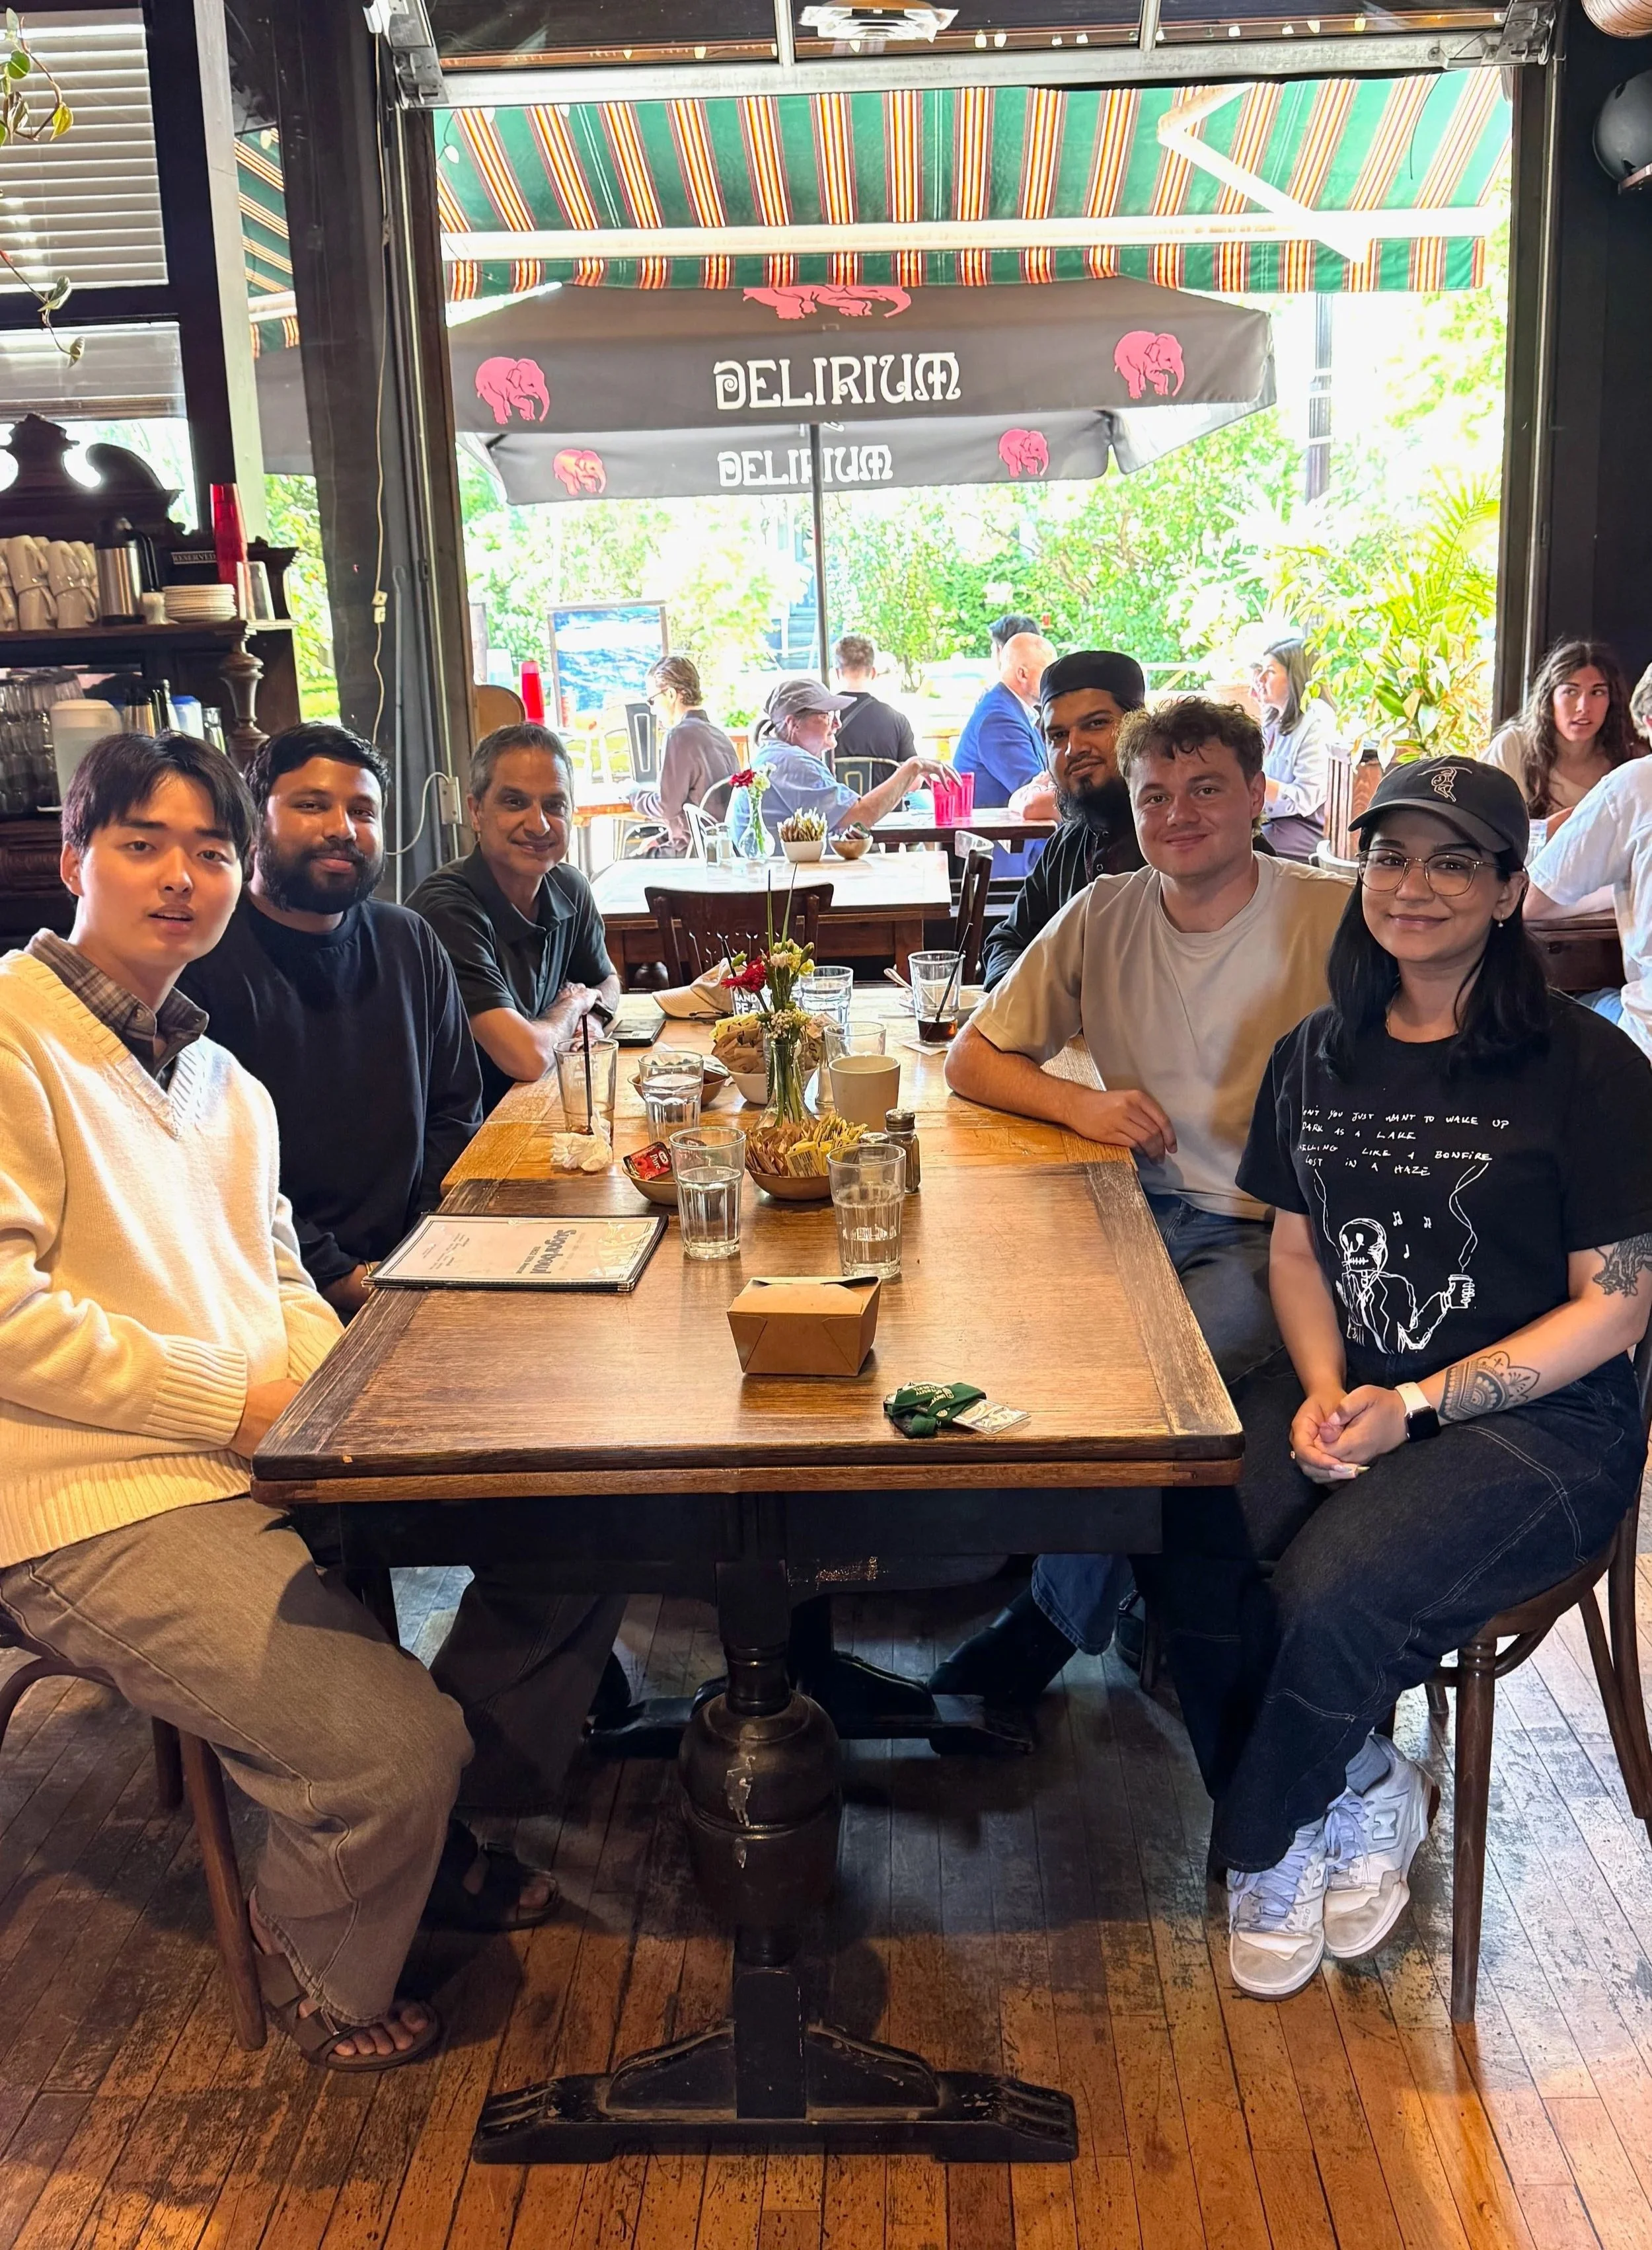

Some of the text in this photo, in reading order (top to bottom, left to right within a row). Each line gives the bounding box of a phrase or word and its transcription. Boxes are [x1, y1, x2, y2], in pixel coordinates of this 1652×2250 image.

[713, 352, 961, 410] DELIRIUM
[1302, 1122, 1324, 1132] DARK
[1328, 1110, 1343, 1120] YOU
[1352, 1112, 1374, 1122] JUST
[1386, 1114, 1415, 1122] WANT
[1445, 1116, 1478, 1125] WAKE
[1492, 1120, 1509, 1129] UP
[1362, 1147, 1391, 1156] LIKE
[650, 1153, 661, 1169] Pure
[1305, 1155, 1323, 1167] LOST
[1371, 1162, 1378, 1172] A
[1394, 1165, 1431, 1176] HAZE
